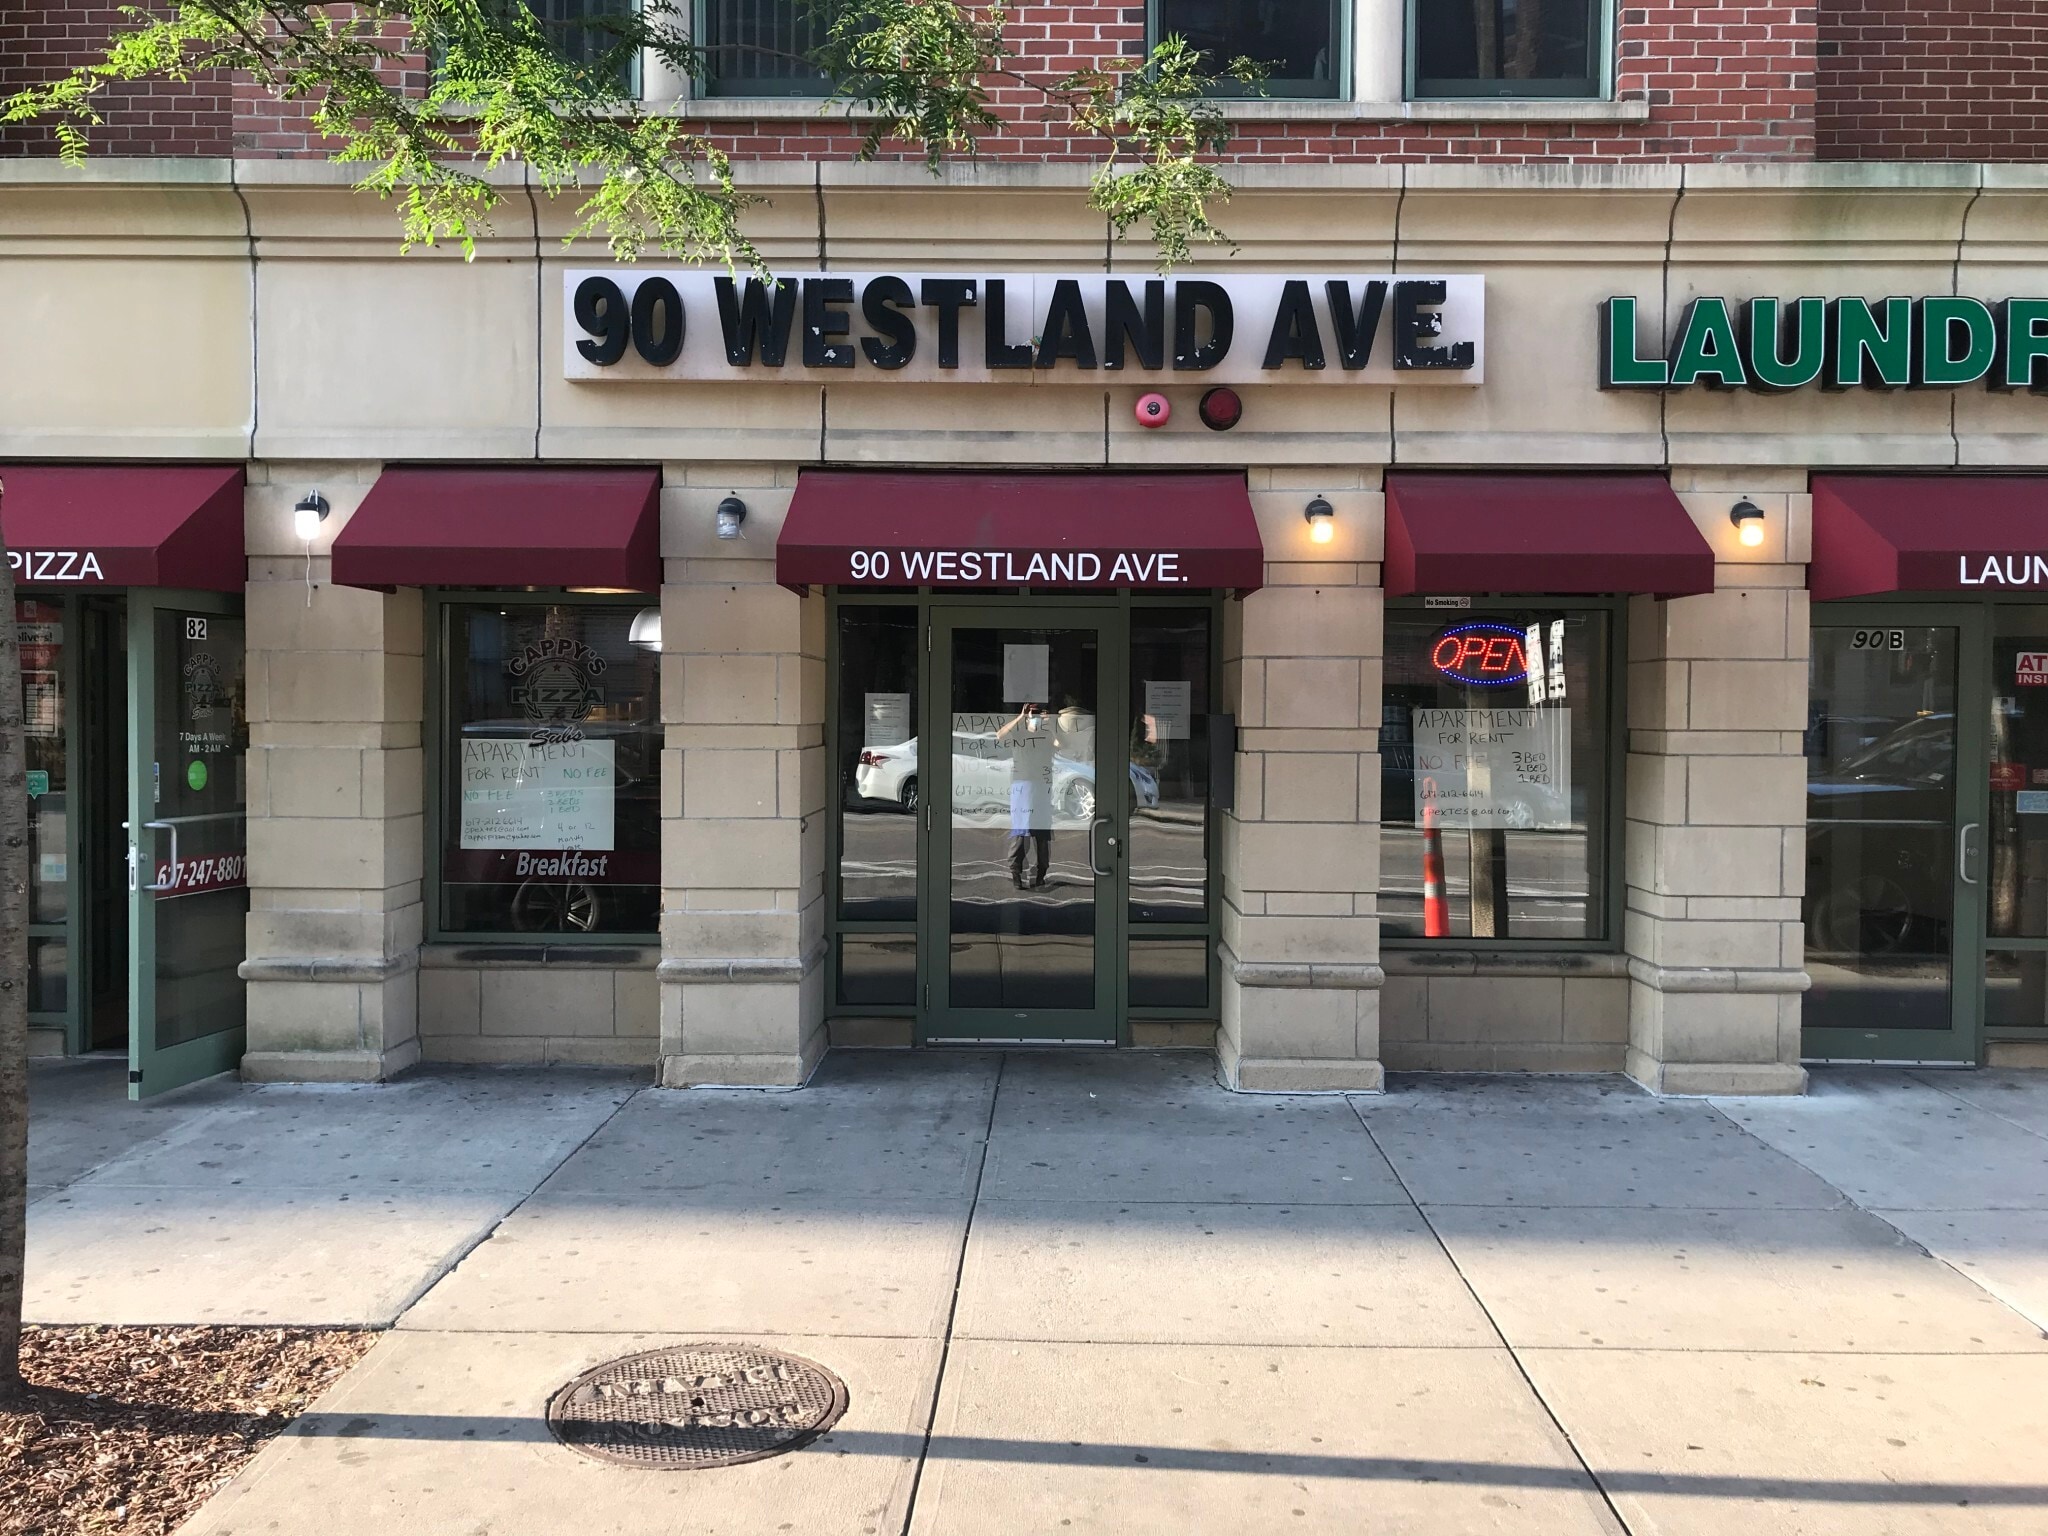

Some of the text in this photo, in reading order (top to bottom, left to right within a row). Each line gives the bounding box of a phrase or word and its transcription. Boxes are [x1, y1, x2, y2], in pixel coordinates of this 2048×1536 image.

[574, 276, 1475, 370] 90 WESTLAND AVE.
[1601, 296, 2048, 391] LAUNDR
[6, 551, 104, 580] PIZZA
[849, 551, 1189, 582] 90 WESTLAND AVE.
[1959, 555, 2048, 584] LAUN
[1435, 598, 1459, 607] Smoking
[187, 619, 206, 639] 82
[1852, 630, 1903, 649] 90 B
[508, 637, 608, 677] CAPPY'S
[1433, 636, 1530, 672] OPEN
[184, 652, 222, 677] CAPPY'S
[2017, 655, 2048, 672] AT
[2018, 673, 2048, 684] INSI
[512, 688, 601, 703] PIZZA
[1418, 710, 1535, 729] APARTMENT
[179, 732, 226, 743] 7 Days A Week
[528, 727, 585, 748] Subs
[961, 736, 1046, 750] FOR RENT
[1438, 732, 1514, 744] FOR RENT
[464, 740, 591, 764] APARTMENT
[1512, 751, 1546, 764] 3 BED
[1420, 754, 1487, 770] NO FEE
[1516, 763, 1548, 773] 2 BED
[467, 766, 545, 782] FOR RENT
[563, 767, 608, 779] NO FEE
[1529, 774, 1551, 784] BED
[464, 790, 513, 801] NO FEE
[515, 852, 609, 877] Breakfast
